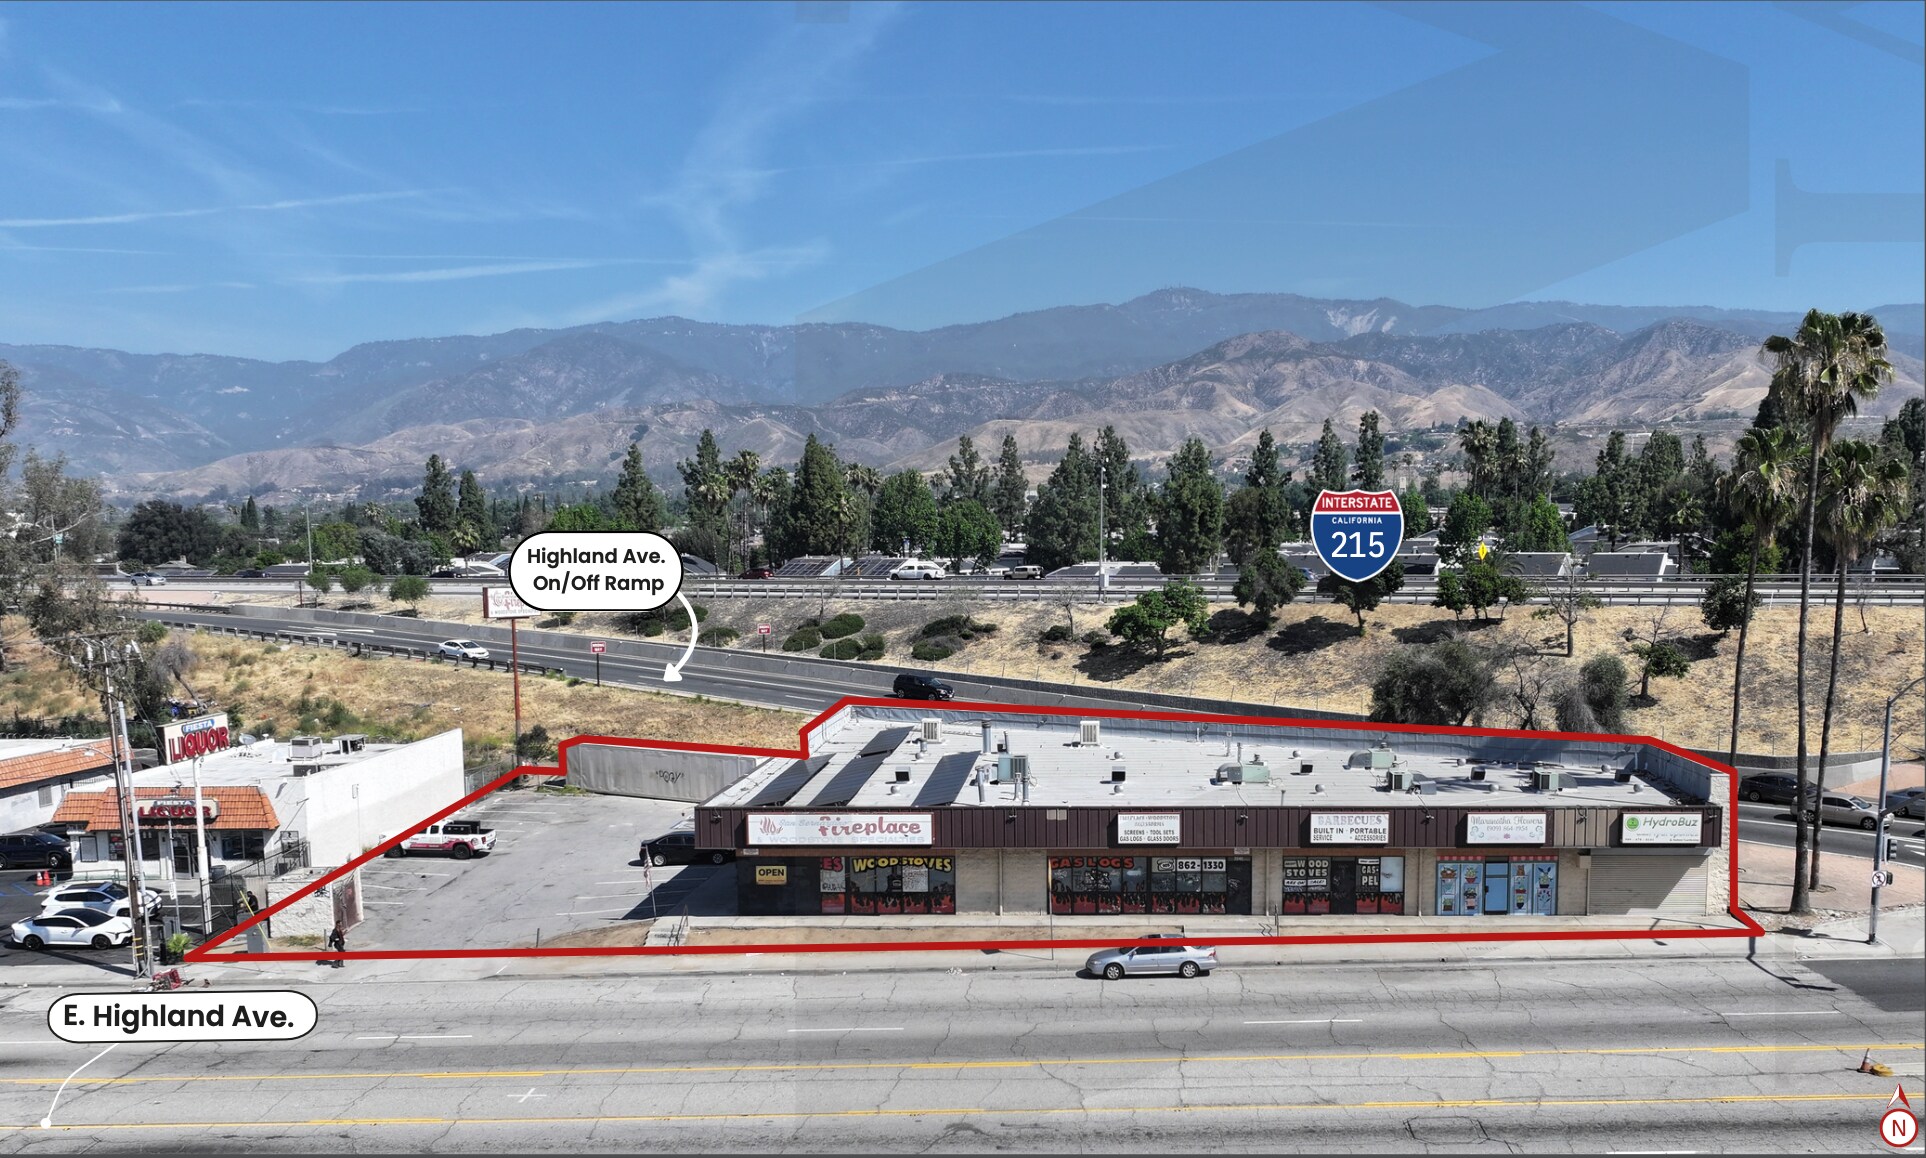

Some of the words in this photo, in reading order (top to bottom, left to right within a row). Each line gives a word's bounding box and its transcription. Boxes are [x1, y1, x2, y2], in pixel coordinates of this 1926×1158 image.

[185, 720, 213, 732] FIESTA
[168, 727, 230, 763] LIQUOR
[138, 806, 212, 817] LIQUOR
[1317, 815, 1382, 826] BARBECUES
[1513, 815, 1543, 825] Flowers
[1642, 816, 1699, 829] HydroBuz
[1349, 827, 1387, 835] PORTABLE
[769, 836, 844, 844] WOODSTOVE
[1354, 834, 1387, 842] ACCESSORIES
[1050, 857, 1085, 869] GAS
[1087, 857, 1135, 869] LOGS
[1178, 860, 1224, 870] 862-1330
[1297, 860, 1329, 868] WOOD
[758, 868, 785, 877] OPEN
[1286, 869, 1328, 877] STOVES
[1362, 876, 1379, 886] PEL
